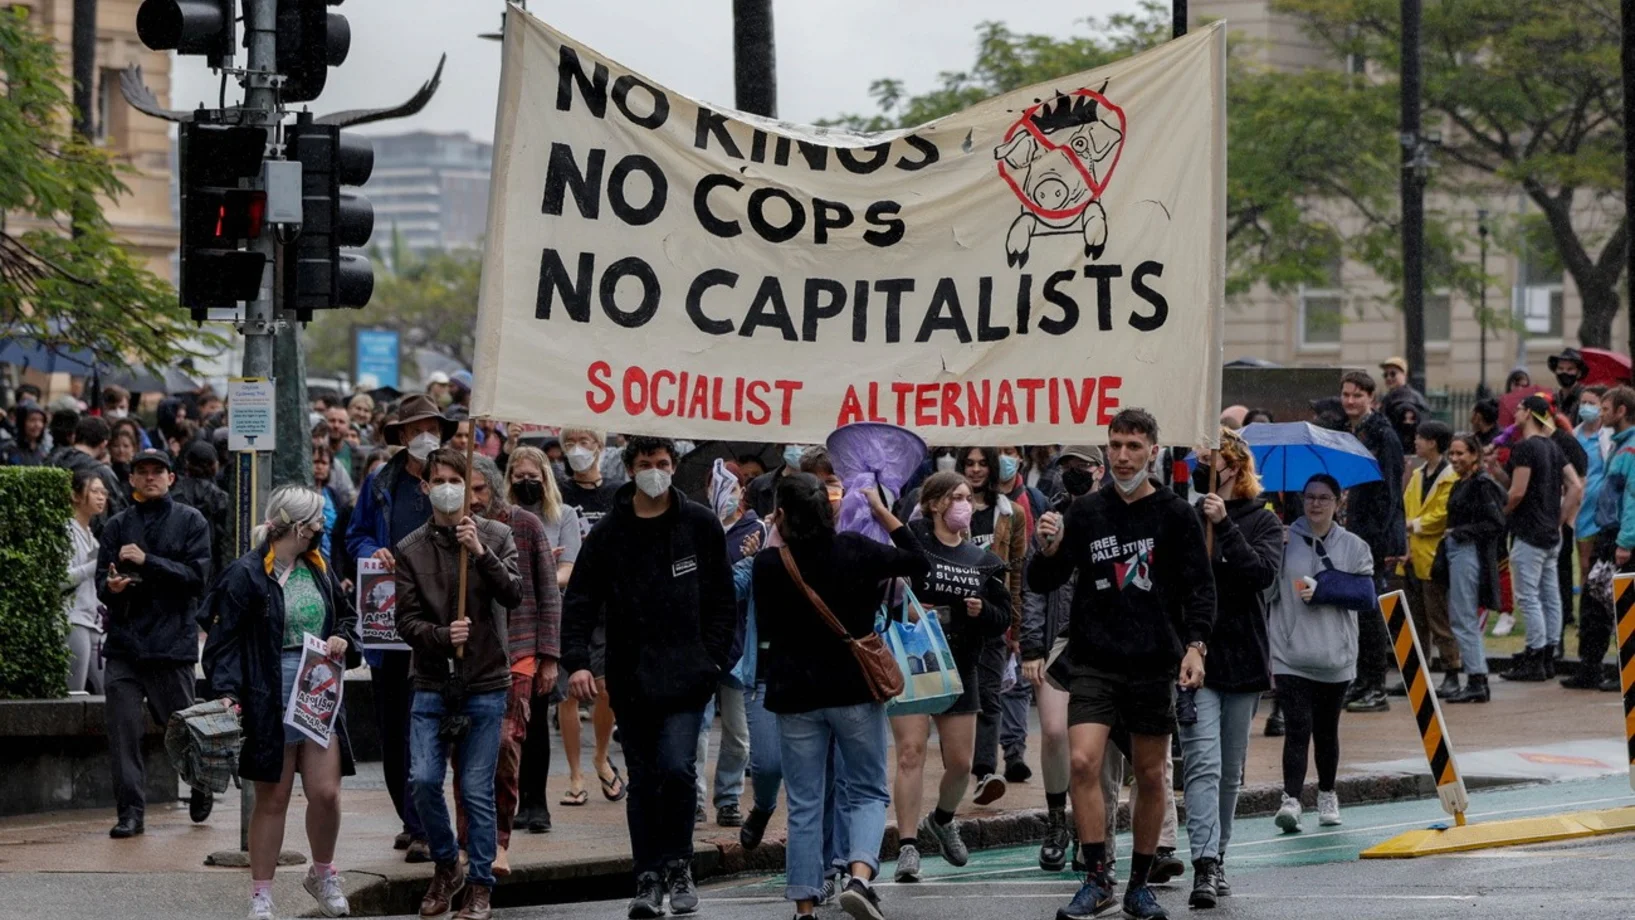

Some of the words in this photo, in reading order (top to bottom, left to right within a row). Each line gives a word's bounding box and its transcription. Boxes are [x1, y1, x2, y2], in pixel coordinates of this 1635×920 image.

[556, 45, 670, 131] NO
[694, 106, 940, 175] KINGS
[541, 142, 668, 226] NO
[693, 173, 906, 248] COPS
[536, 248, 661, 329] NO
[685, 260, 1169, 344] CAPITALISTS
[586, 360, 804, 426] SOCIALIST
[836, 375, 1123, 428] ALTERNATIVE
[1089, 535, 1118, 553] FREE
[1091, 537, 1155, 564] PALESTINE
[935, 582, 977, 597] MASTE
[936, 571, 980, 587] SLAVES
[298, 691, 334, 710] ABOLISH
